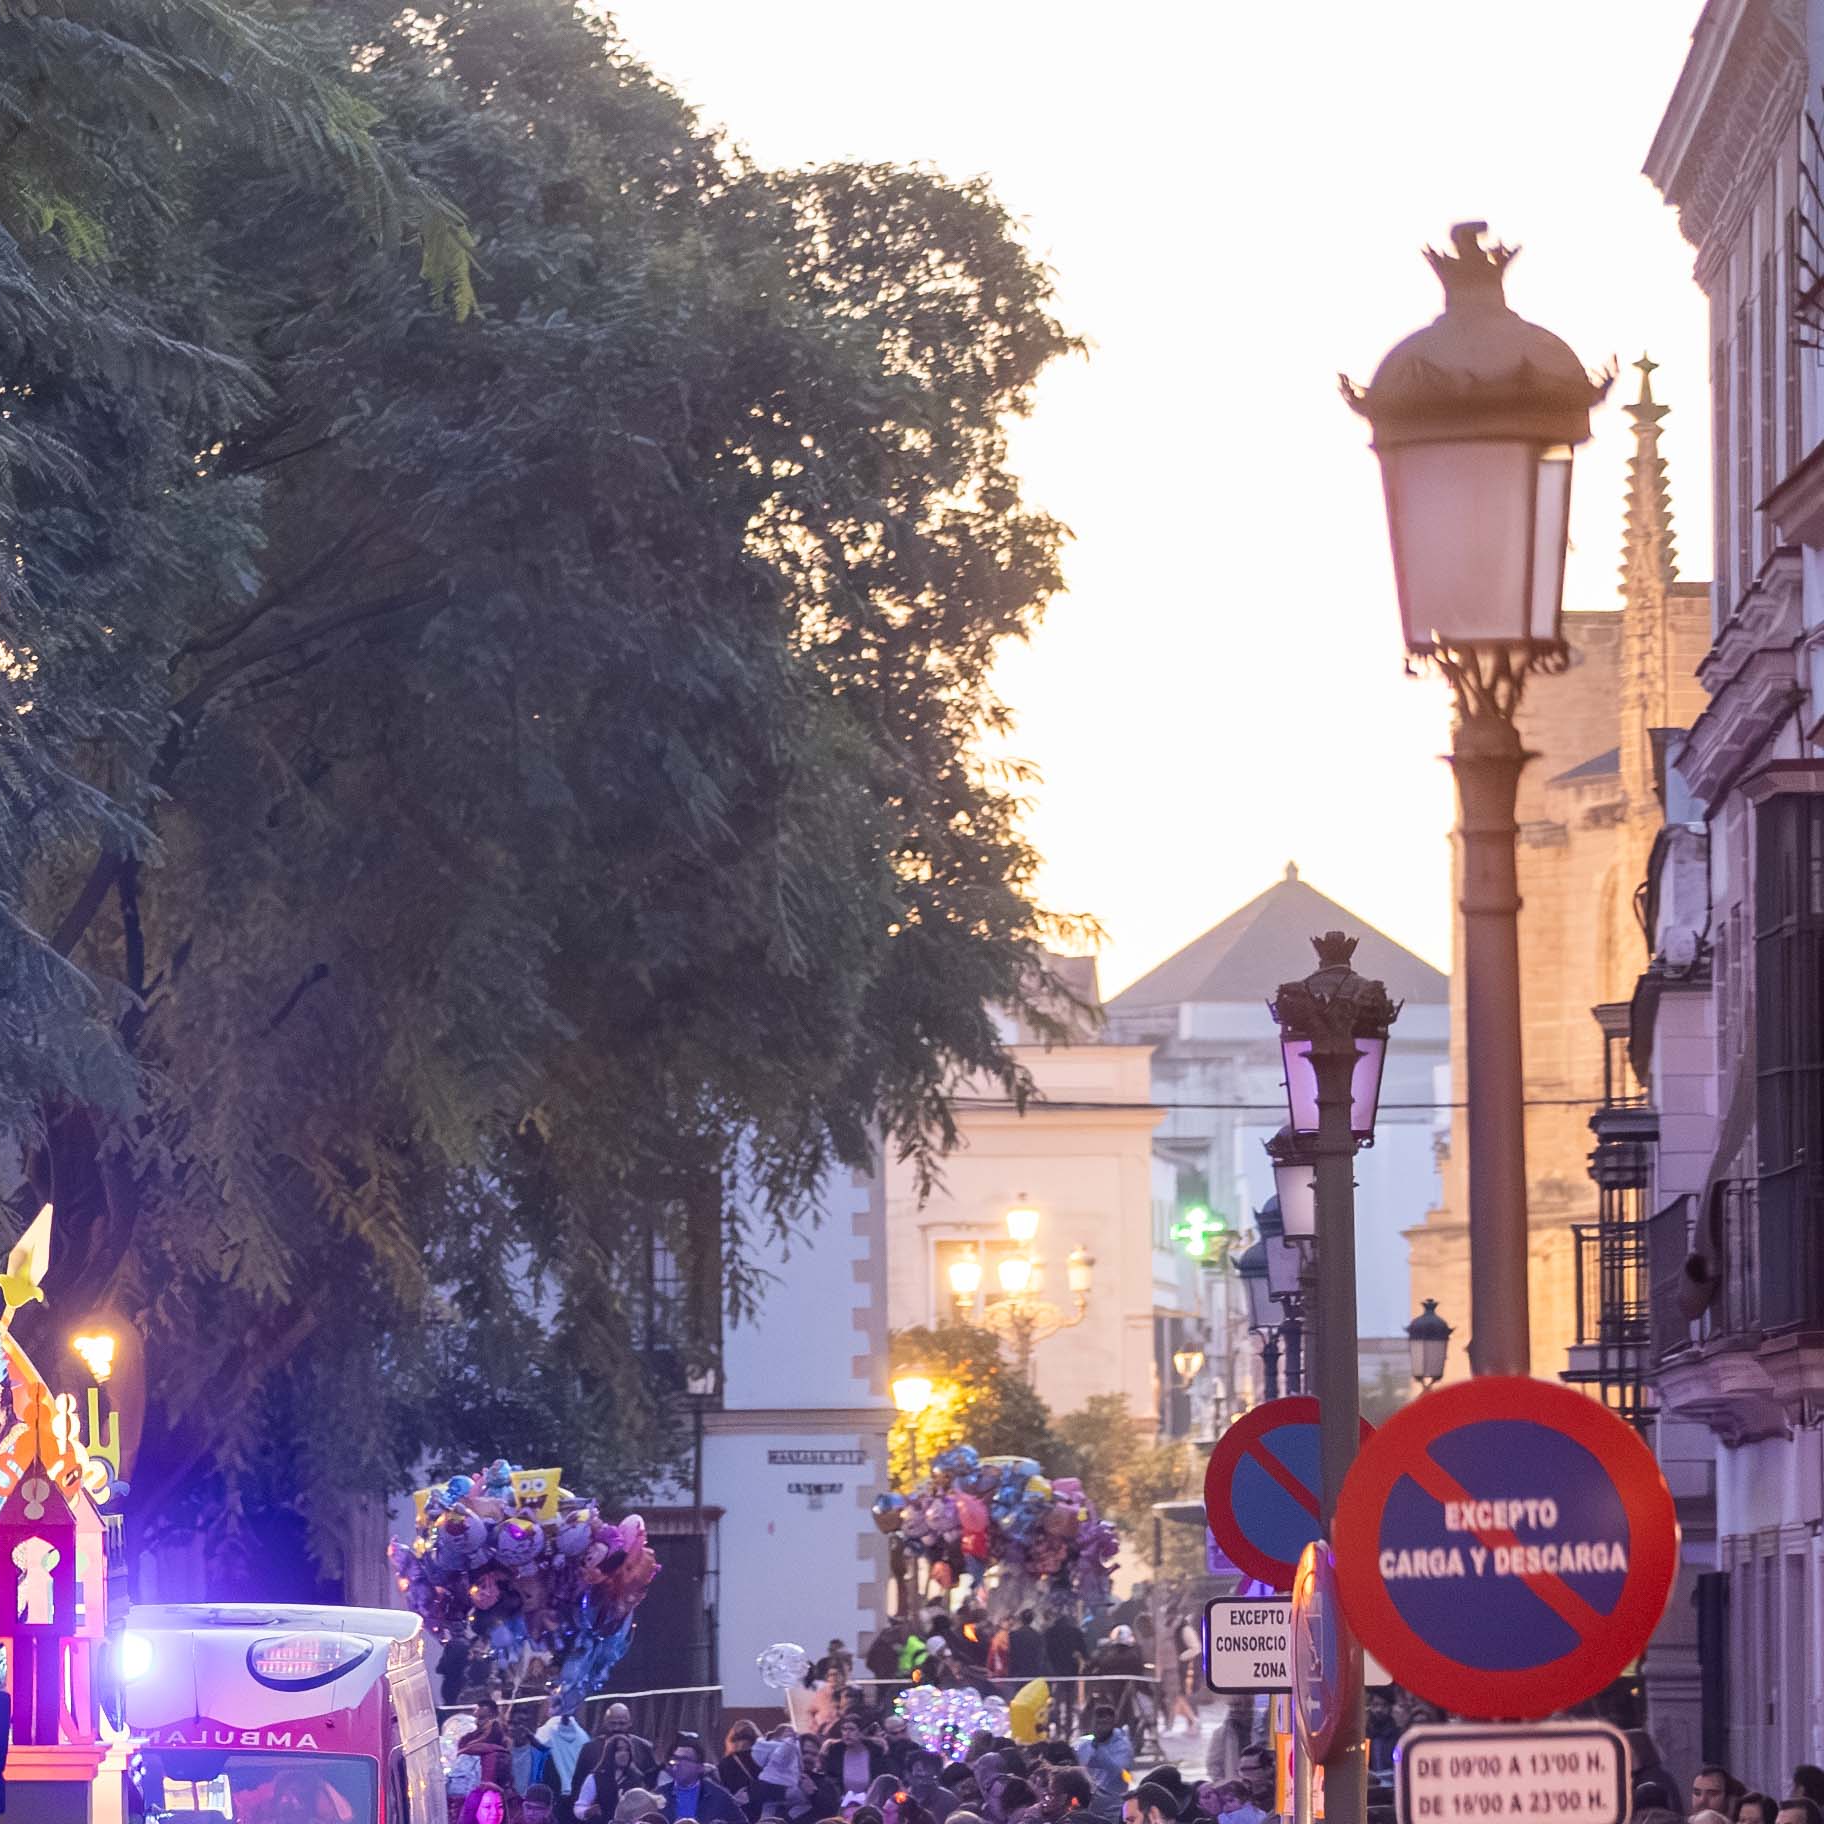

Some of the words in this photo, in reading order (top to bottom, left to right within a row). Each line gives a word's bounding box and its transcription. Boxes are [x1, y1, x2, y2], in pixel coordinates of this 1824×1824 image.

[1444, 1499, 1558, 1531] EXCEPTO
[1379, 1547, 1465, 1579] CARGA
[1470, 1547, 1487, 1576] Y
[1493, 1541, 1627, 1575] DESCARGA
[1230, 1609, 1284, 1625] EXCEPTO
[1216, 1636, 1286, 1652] CONSORCIO
[1253, 1662, 1287, 1678] ZONA
[1417, 1757, 1442, 1778] DE
[1509, 1755, 1521, 1776] A
[1418, 1796, 1443, 1816] DE
[1509, 1793, 1522, 1814] A
